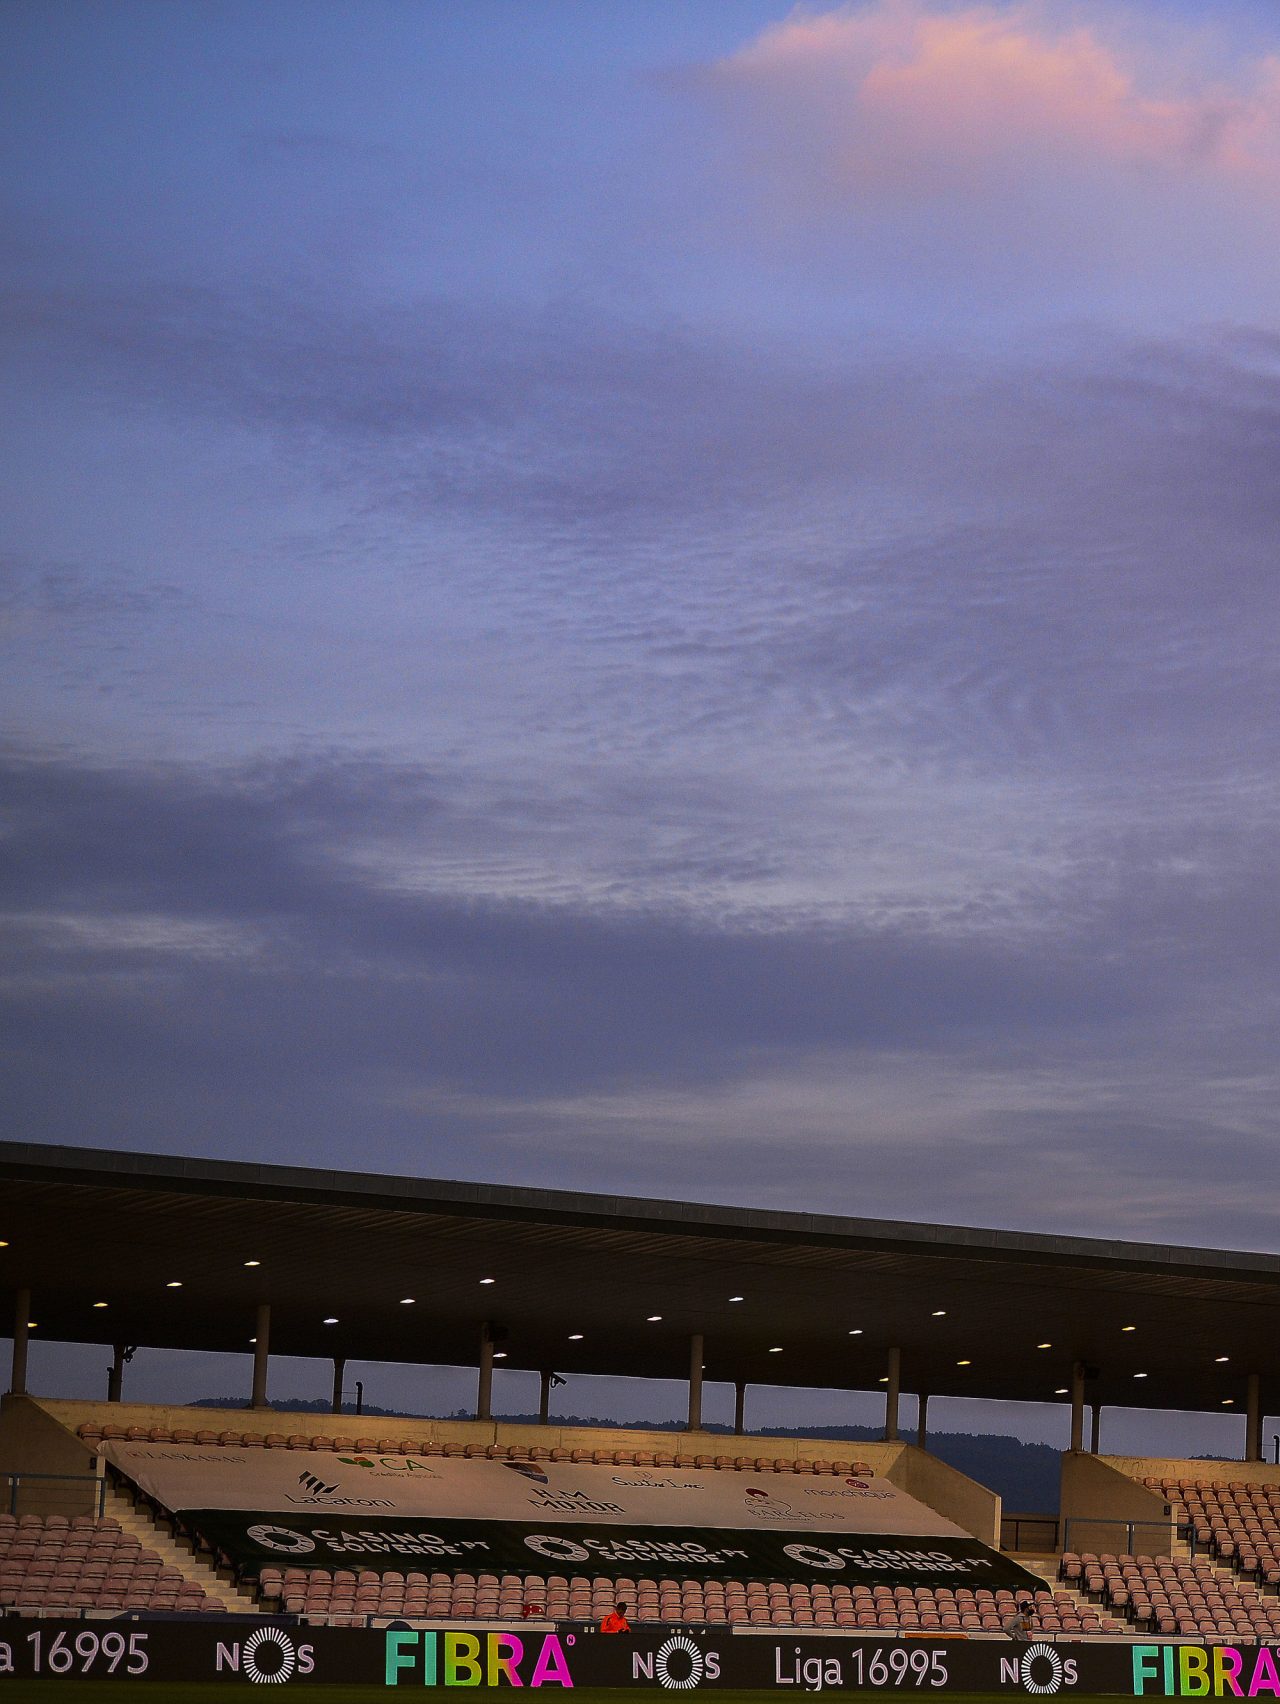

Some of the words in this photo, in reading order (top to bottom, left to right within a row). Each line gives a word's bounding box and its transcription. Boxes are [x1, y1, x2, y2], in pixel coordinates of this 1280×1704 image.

[146, 1451, 246, 1463] LASKASAS
[379, 1458, 434, 1472] CA
[284, 1493, 397, 1507] Lacatoni
[526, 1499, 626, 1513] MOTOR
[311, 1529, 445, 1545] CASINO
[582, 1538, 707, 1554] CASINO
[837, 1548, 953, 1563] CASINO
[27, 1631, 149, 1674] 16995
[216, 1627, 315, 1684] NOS
[385, 1631, 574, 1688] FIBRA
[632, 1636, 722, 1689] NOS
[775, 1647, 843, 1692] Liga
[852, 1648, 948, 1687] 16995
[1000, 1643, 1079, 1694] NOS
